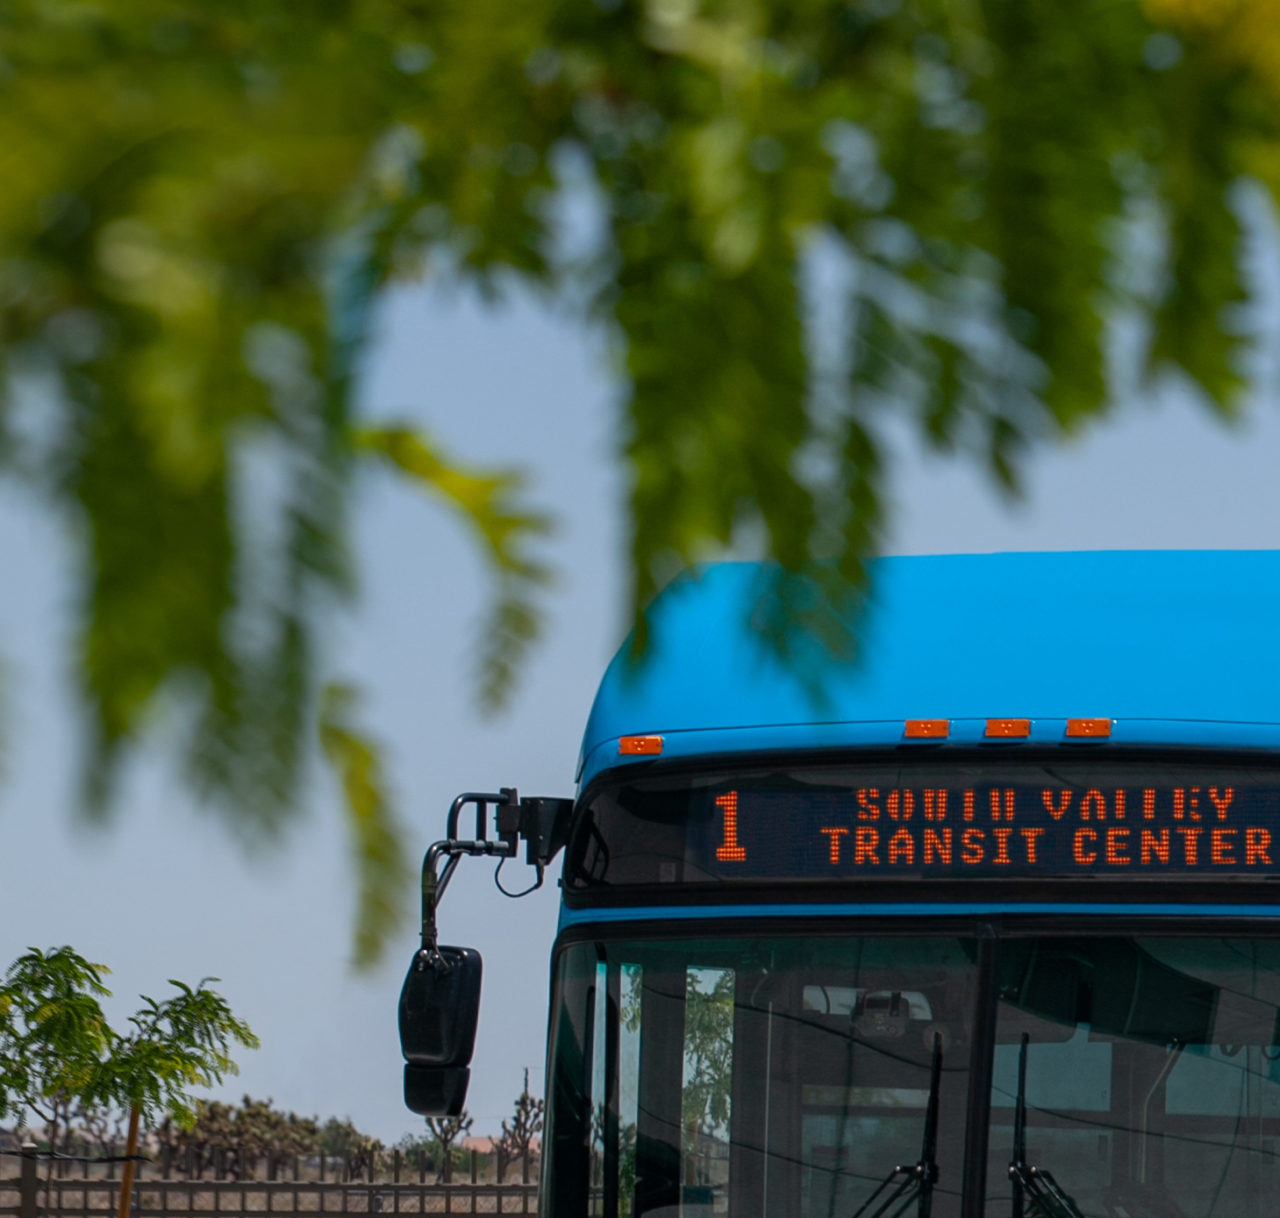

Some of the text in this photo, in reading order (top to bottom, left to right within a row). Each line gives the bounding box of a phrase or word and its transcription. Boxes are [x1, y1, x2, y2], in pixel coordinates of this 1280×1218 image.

[715, 791, 747, 861] 1
[820, 826, 1273, 865] TRANSIT CENTER
